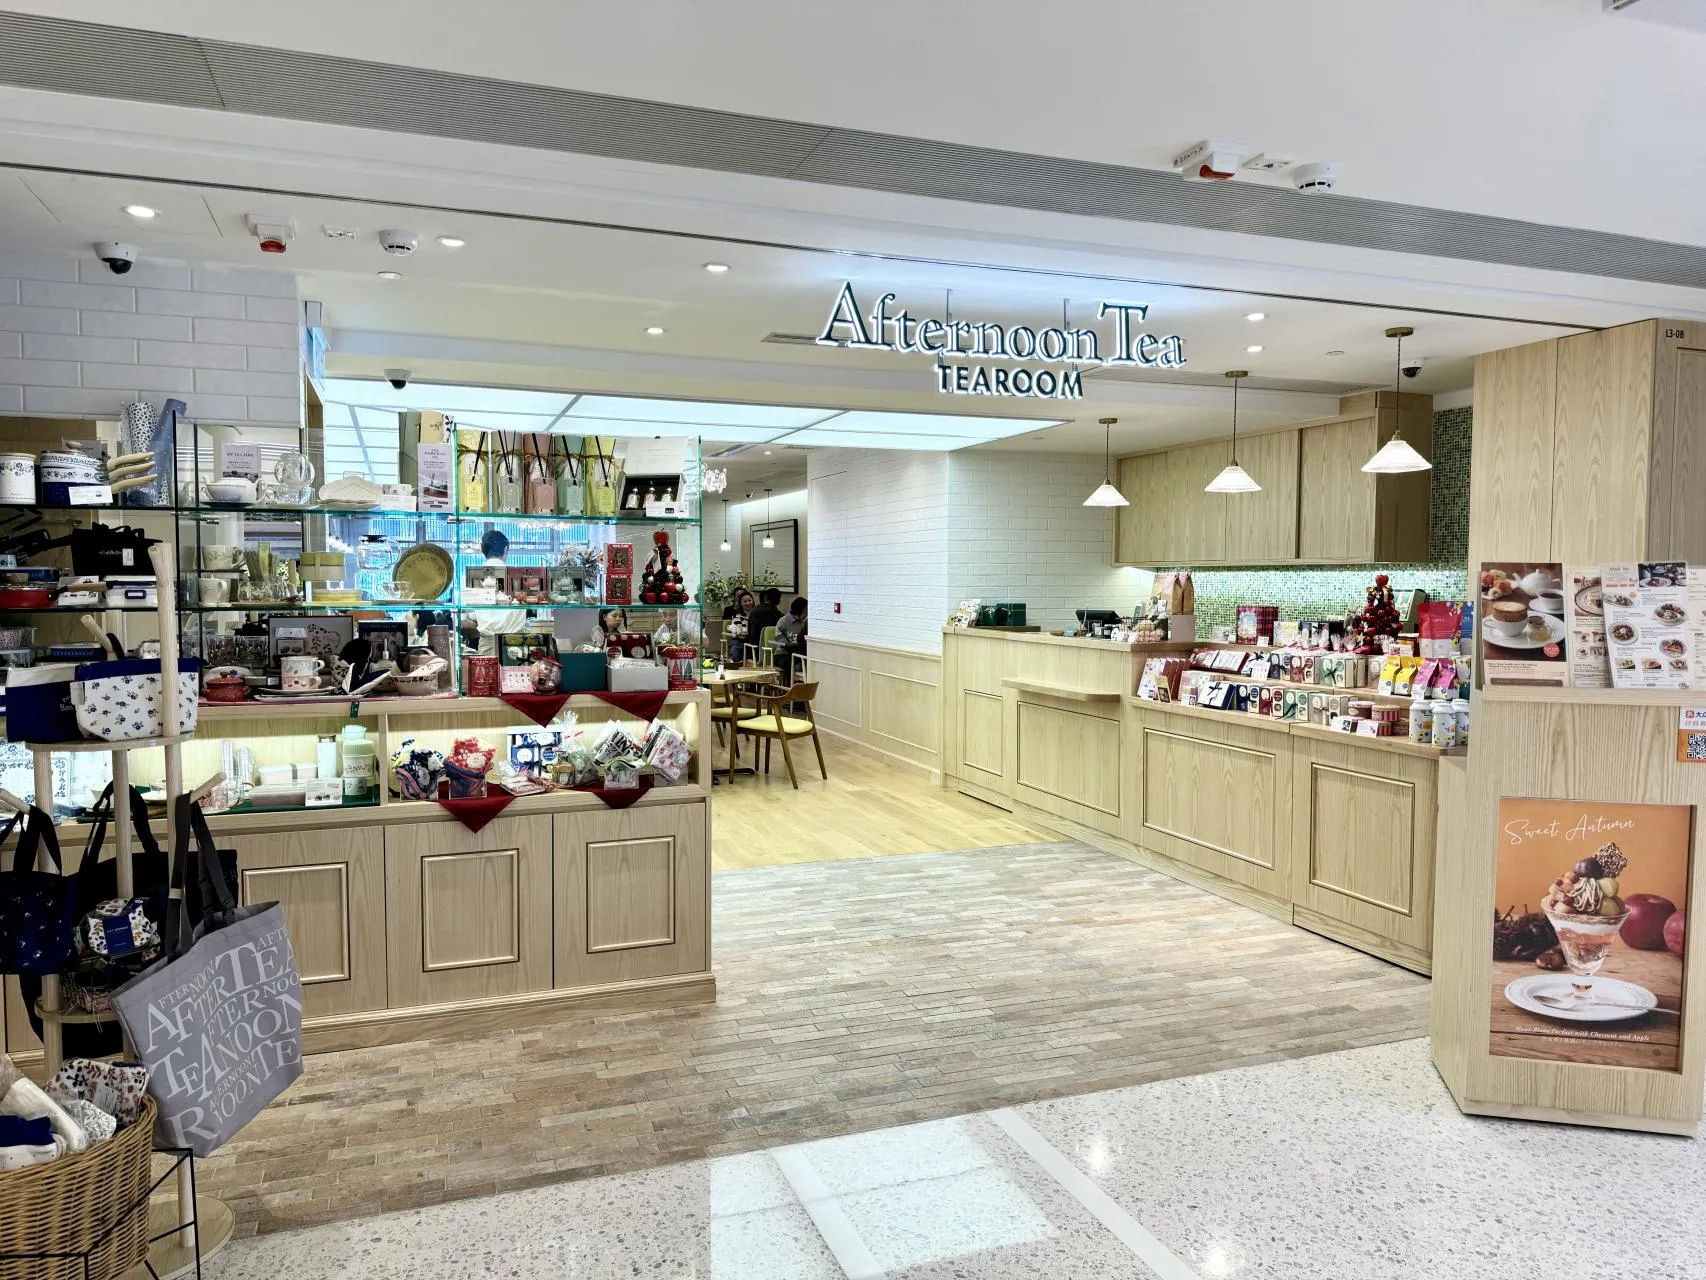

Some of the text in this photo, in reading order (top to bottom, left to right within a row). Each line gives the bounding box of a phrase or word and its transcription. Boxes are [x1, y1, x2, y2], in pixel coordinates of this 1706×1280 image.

[816, 281, 1187, 368] Afternoon Tea
[1665, 328, 1685, 339] L3-08
[936, 364, 1084, 399] TEAROOM
[1505, 814, 1635, 845] Sweet Autumn
[1551, 1028, 1574, 1036] Parfait
[1590, 1031, 1617, 1039] Chestnut
[1632, 1034, 1650, 1042] Apple
